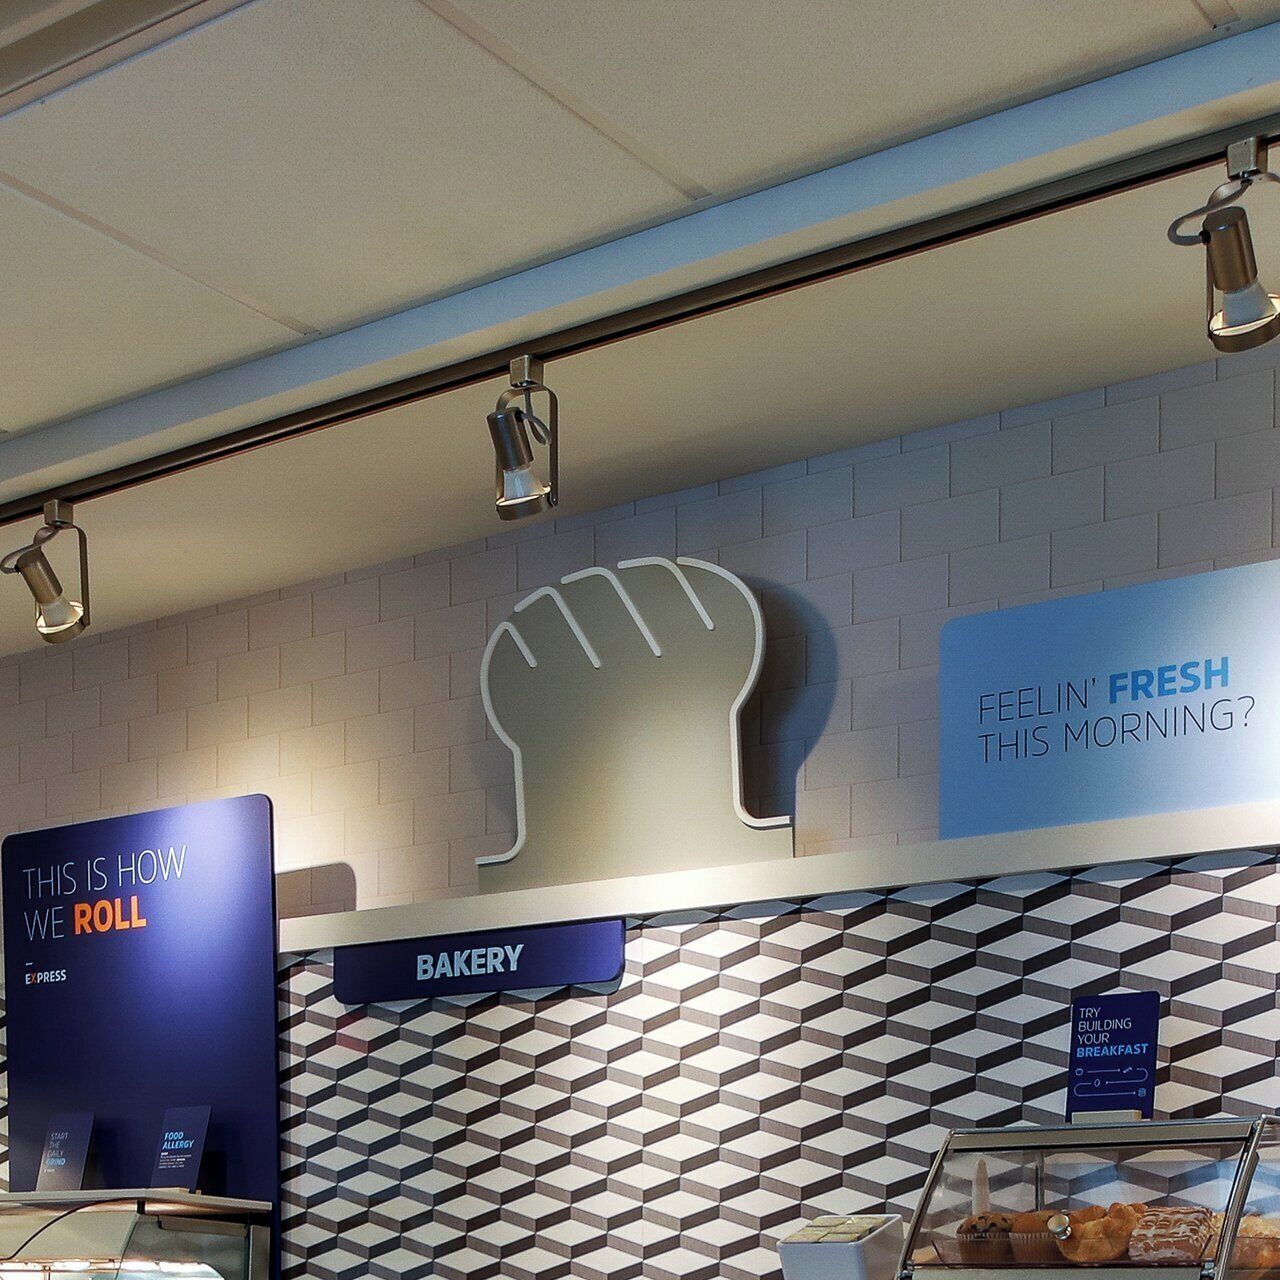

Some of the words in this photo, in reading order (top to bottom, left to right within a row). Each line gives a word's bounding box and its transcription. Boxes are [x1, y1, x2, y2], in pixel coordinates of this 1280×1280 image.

[1109, 656, 1229, 704] FRESH
[978, 725, 1050, 763] THIS
[1064, 695, 1255, 752] MORNING?
[23, 861, 77, 899] THIS
[87, 857, 108, 891] IS
[118, 845, 187, 887] HOW
[23, 906, 65, 941] WE
[74, 895, 147, 935] ROLL
[416, 944, 524, 981] BAKERY
[25, 969, 67, 985] EXPRESS
[1079, 1007, 1101, 1019] TRY
[1078, 1018, 1132, 1032] BUILDING
[1077, 1032, 1110, 1045] YOUR
[1076, 1043, 1149, 1058] BREAKFAST
[164, 1131, 184, 1140] FOOD
[162, 1140, 195, 1150] ALLERGY
